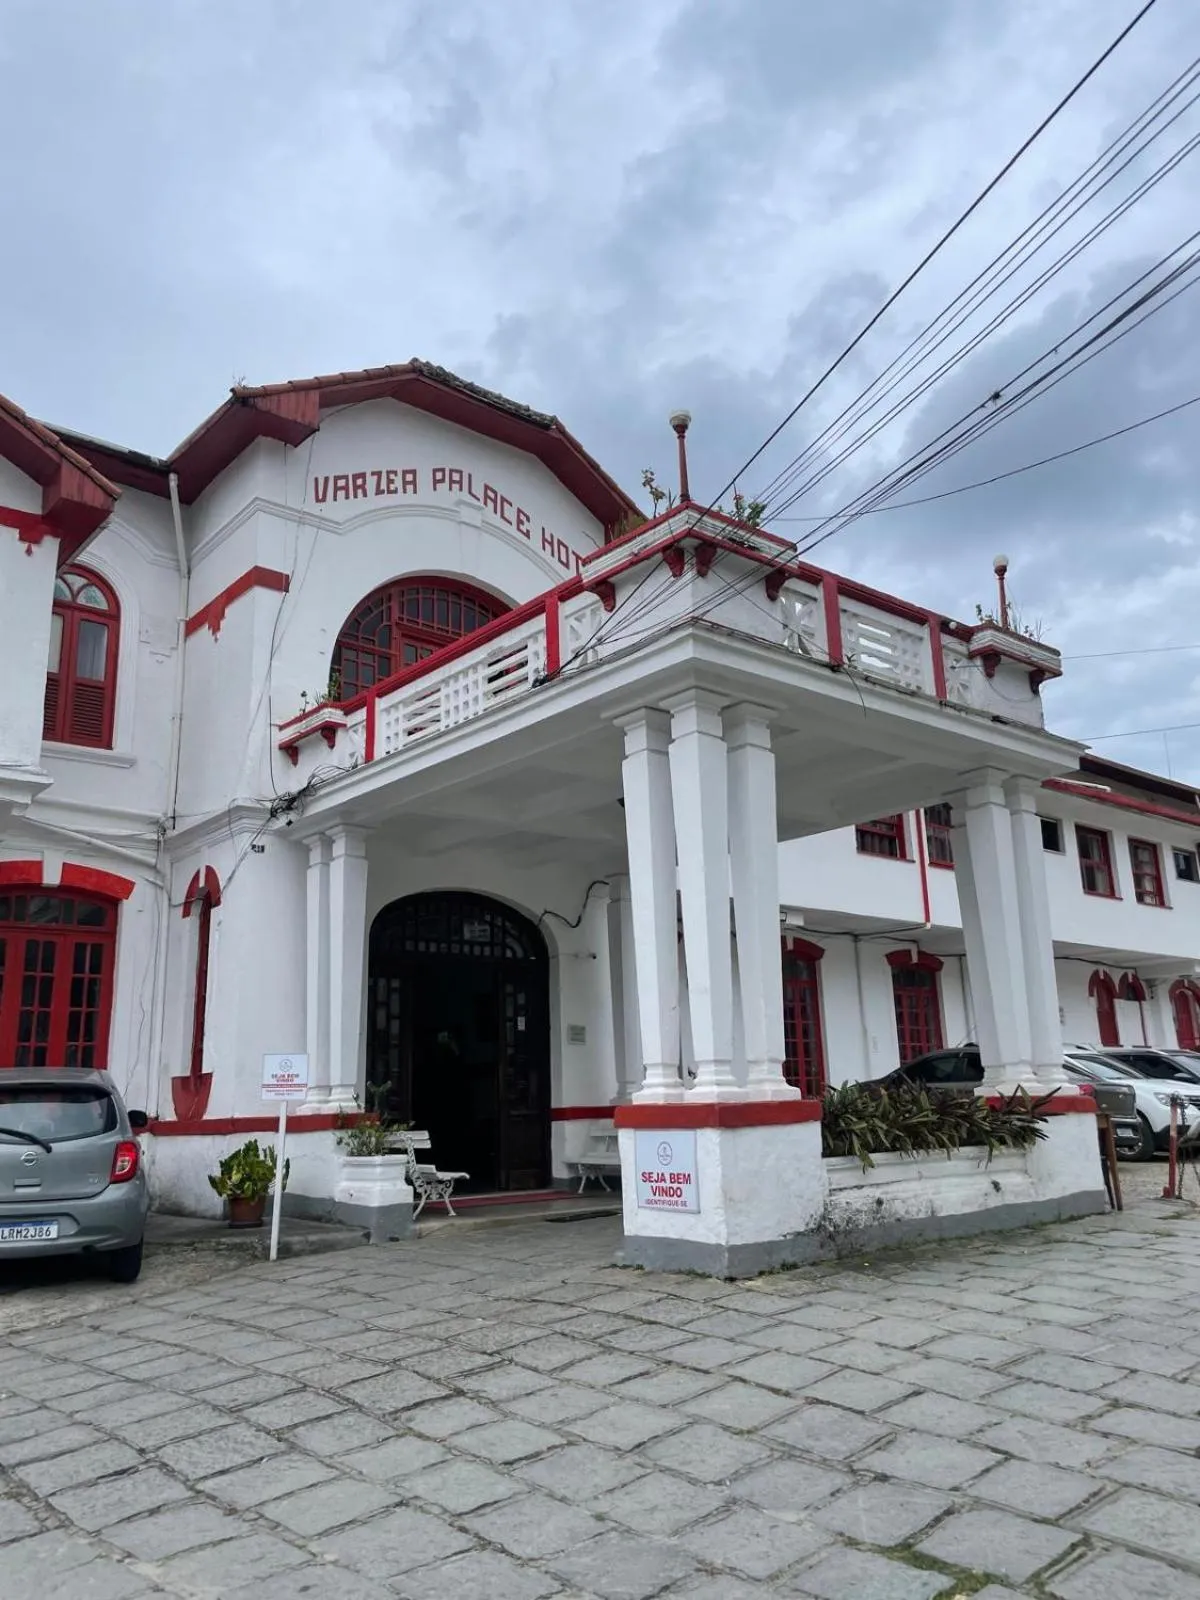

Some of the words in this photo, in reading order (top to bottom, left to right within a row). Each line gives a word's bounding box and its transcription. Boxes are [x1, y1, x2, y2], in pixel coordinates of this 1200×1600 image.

[314, 469, 418, 503] VARZEA
[432, 467, 531, 539] PALACE
[641, 1171, 667, 1184] SEJA
[669, 1173, 692, 1185] BEM
[650, 1185, 683, 1198] VINDO
